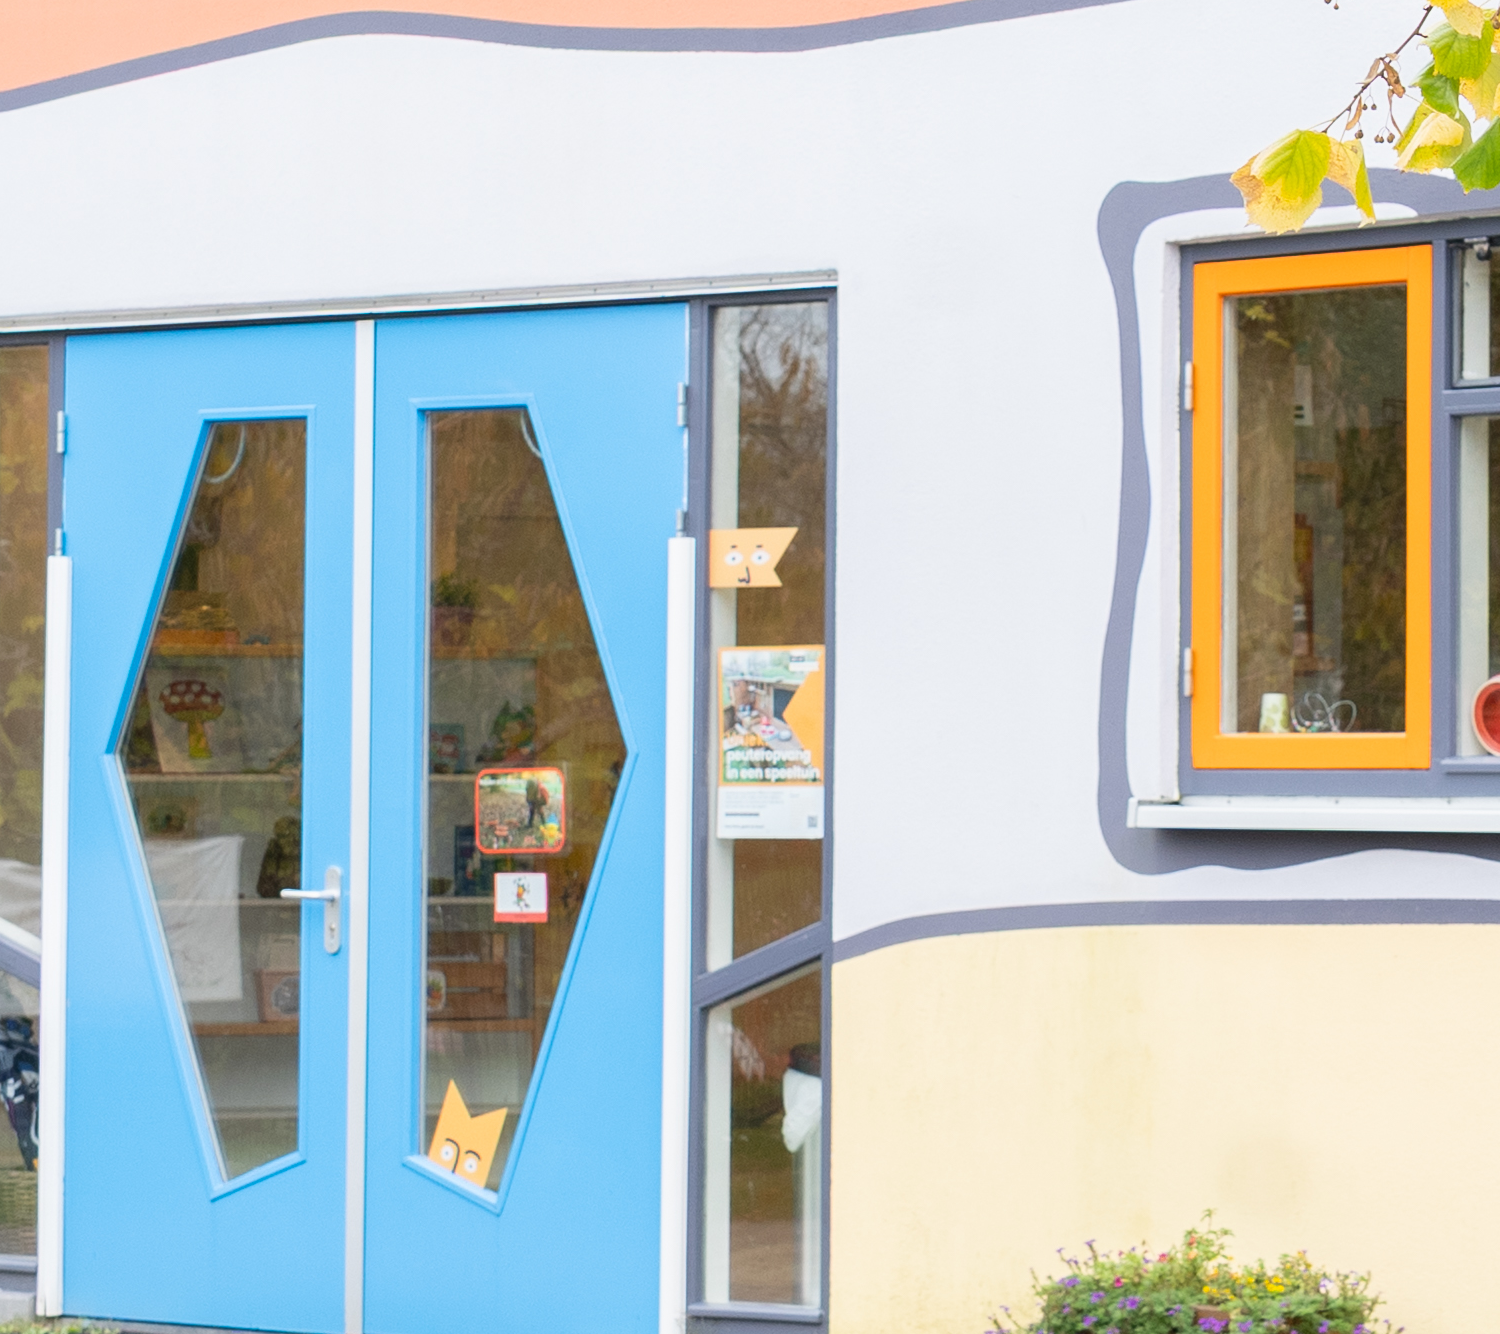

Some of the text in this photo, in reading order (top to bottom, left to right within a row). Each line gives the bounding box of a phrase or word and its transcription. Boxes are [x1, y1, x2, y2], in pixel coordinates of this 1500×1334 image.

[726, 749, 811, 766] peuteropvang
[726, 765, 820, 782] in een speeltuin
